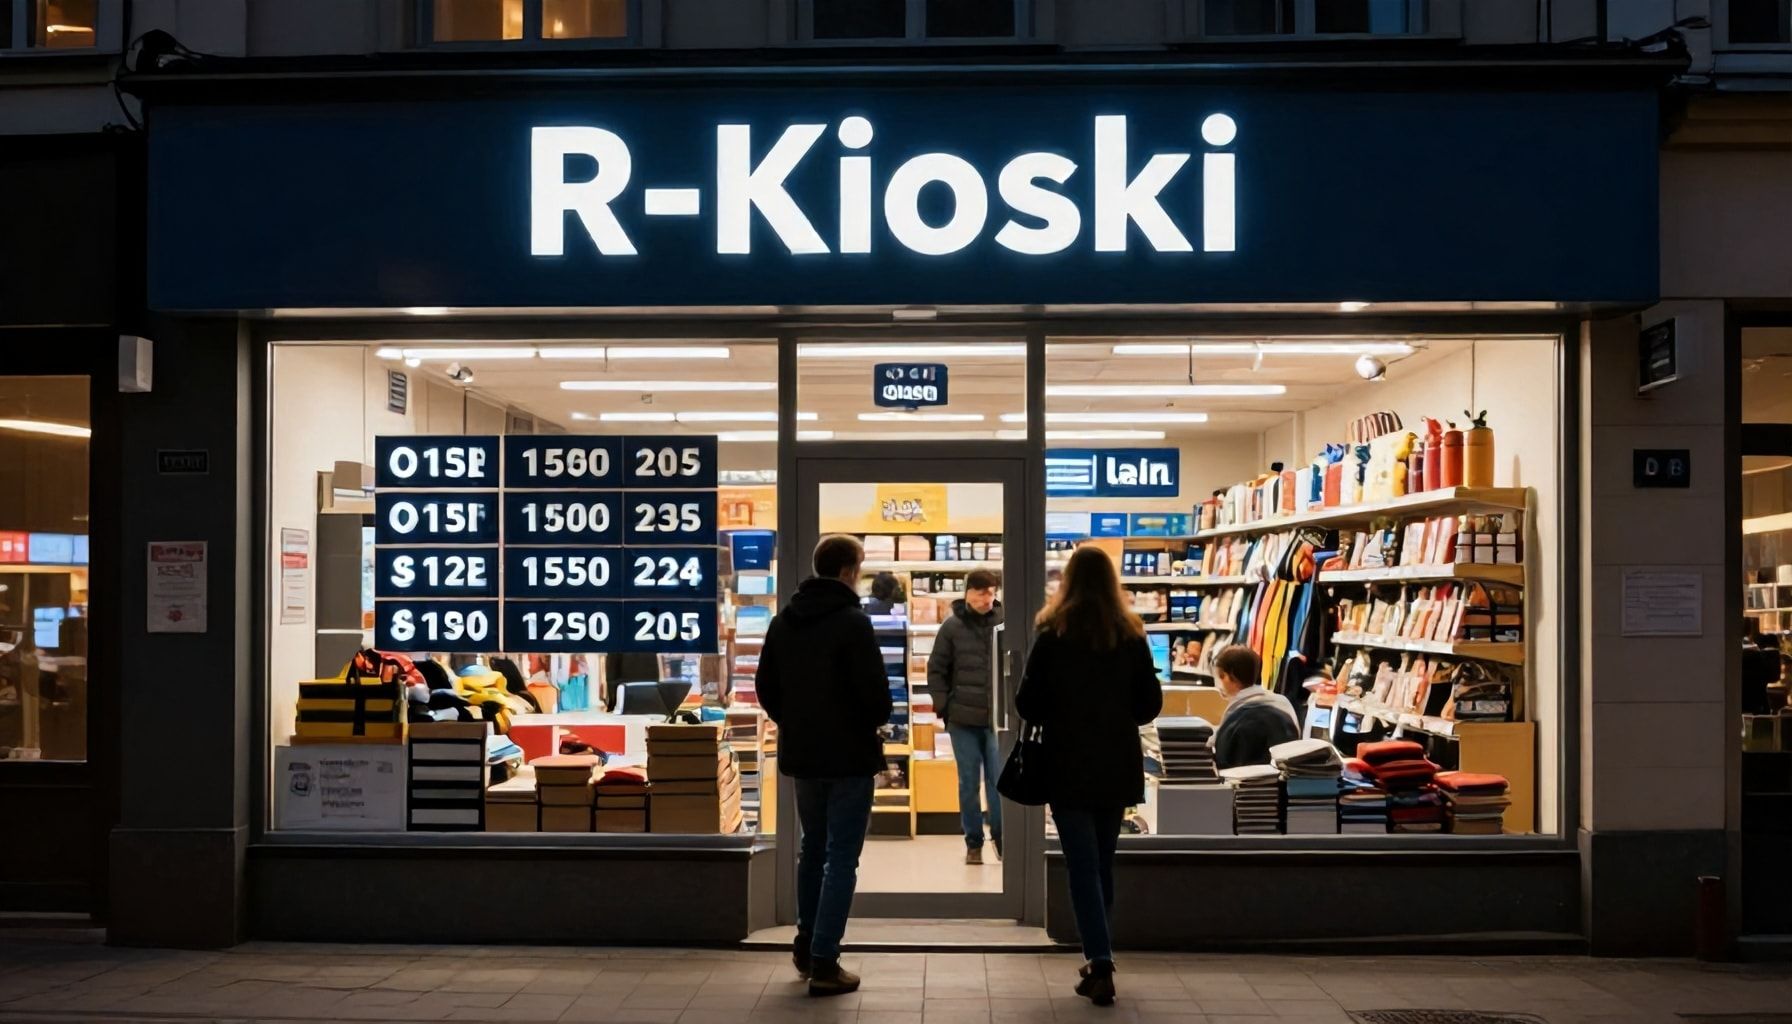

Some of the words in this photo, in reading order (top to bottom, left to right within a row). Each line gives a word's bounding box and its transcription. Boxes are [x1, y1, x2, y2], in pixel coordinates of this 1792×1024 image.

[531, 113, 1237, 256] R-Kioski
[635, 447, 701, 477] 205
[634, 502, 702, 532] 235
[522, 556, 610, 587] 1550
[633, 556, 703, 587] 224
[522, 611, 610, 642] 1250
[634, 611, 701, 641] 205
